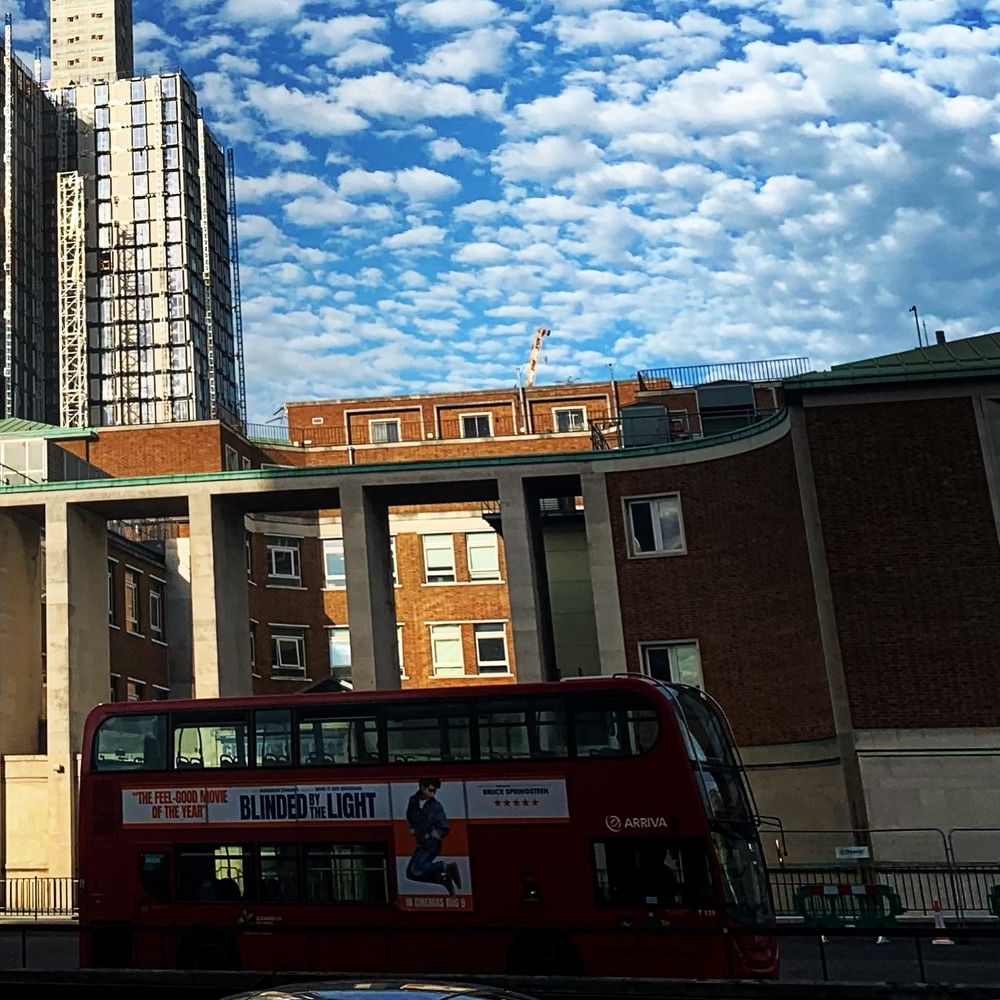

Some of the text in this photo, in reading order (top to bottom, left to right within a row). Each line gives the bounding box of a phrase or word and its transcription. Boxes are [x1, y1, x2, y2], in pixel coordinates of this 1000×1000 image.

[154, 790, 199, 804] FEEL-GOOD
[200, 790, 228, 804] MOVIE
[152, 805, 163, 819] OF
[164, 805, 180, 819] THE
[239, 792, 376, 820] BLINDED BY THE LIGHT
[624, 816, 668, 828] ARRIVA
